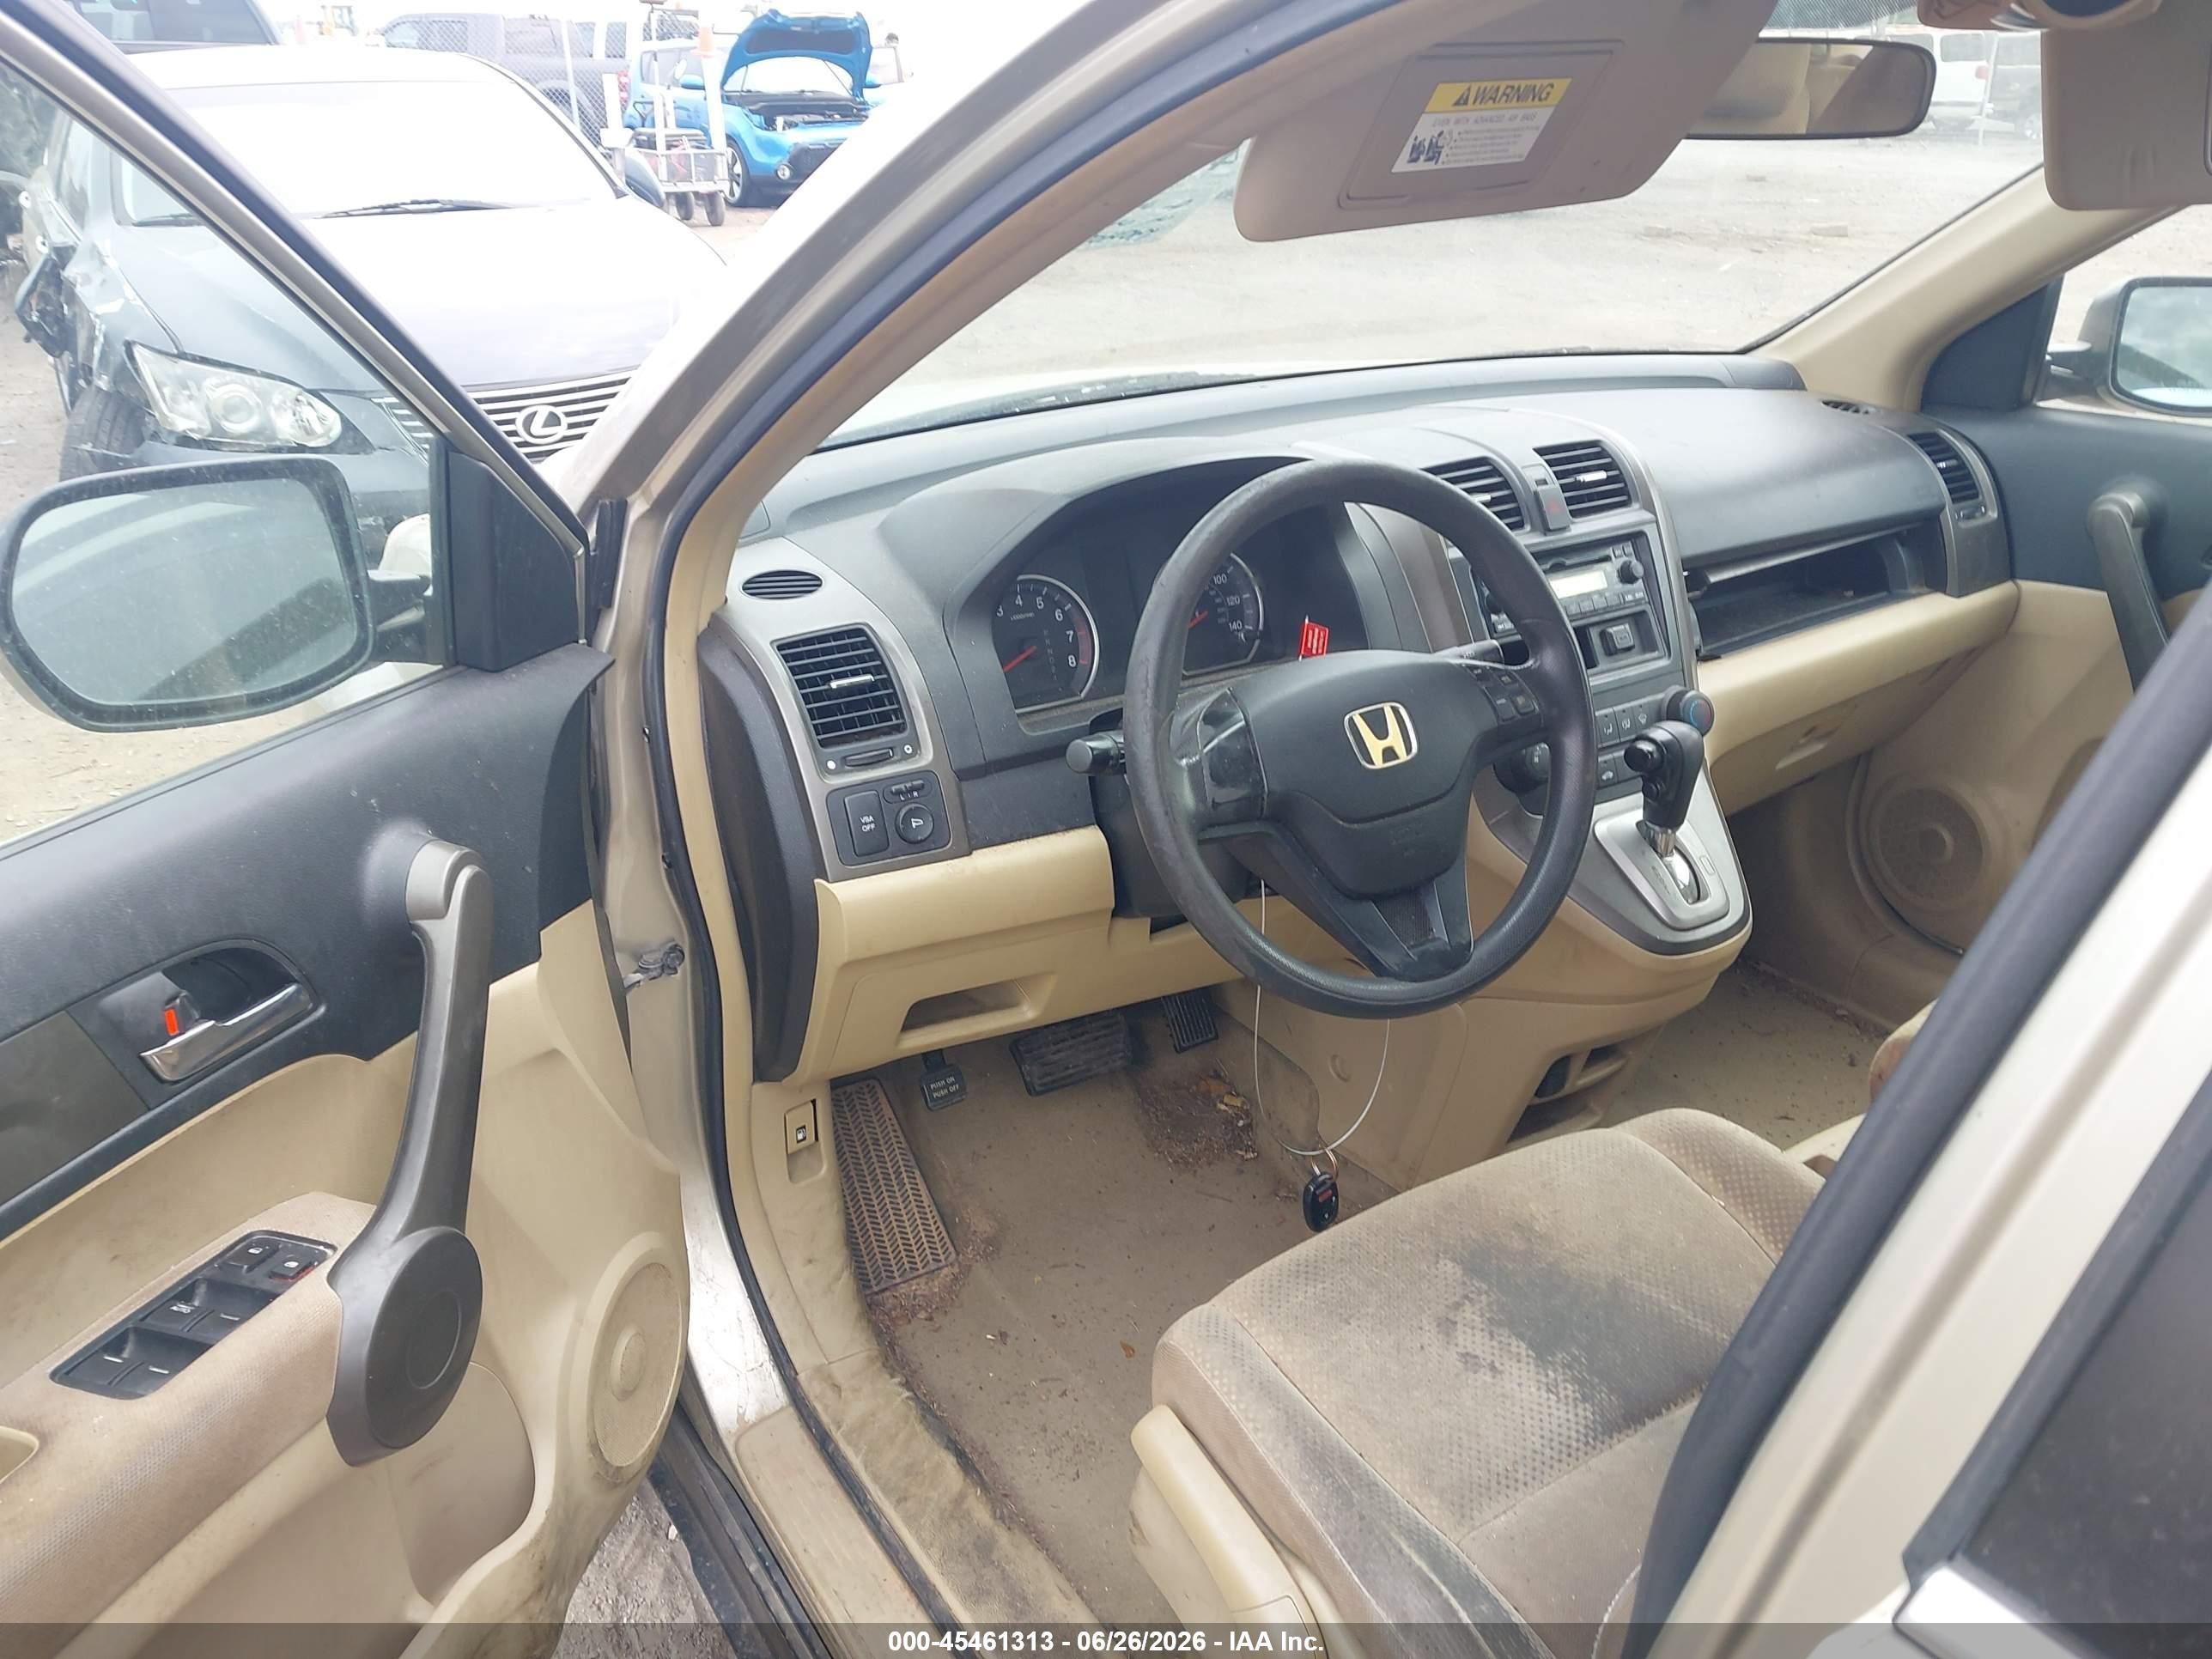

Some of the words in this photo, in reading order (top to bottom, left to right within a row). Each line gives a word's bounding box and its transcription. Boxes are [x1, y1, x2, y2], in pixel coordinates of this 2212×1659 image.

[1472, 82, 1555, 106] WARNING
[1213, 574, 1228, 586] 100
[1015, 594, 1023, 607] 4
[1036, 596, 1044, 609] 5
[1226, 595, 1241, 607] 120
[1054, 609, 1064, 622] 6
[1229, 619, 1243, 631] 140
[1066, 629, 1074, 643] 7
[1067, 654, 1077, 668] 8
[861, 823, 875, 832] OFF
[930, 1079, 945, 1091] PUSH
[933, 1088, 948, 1099] PUSH
[949, 1084, 959, 1092] OFF
